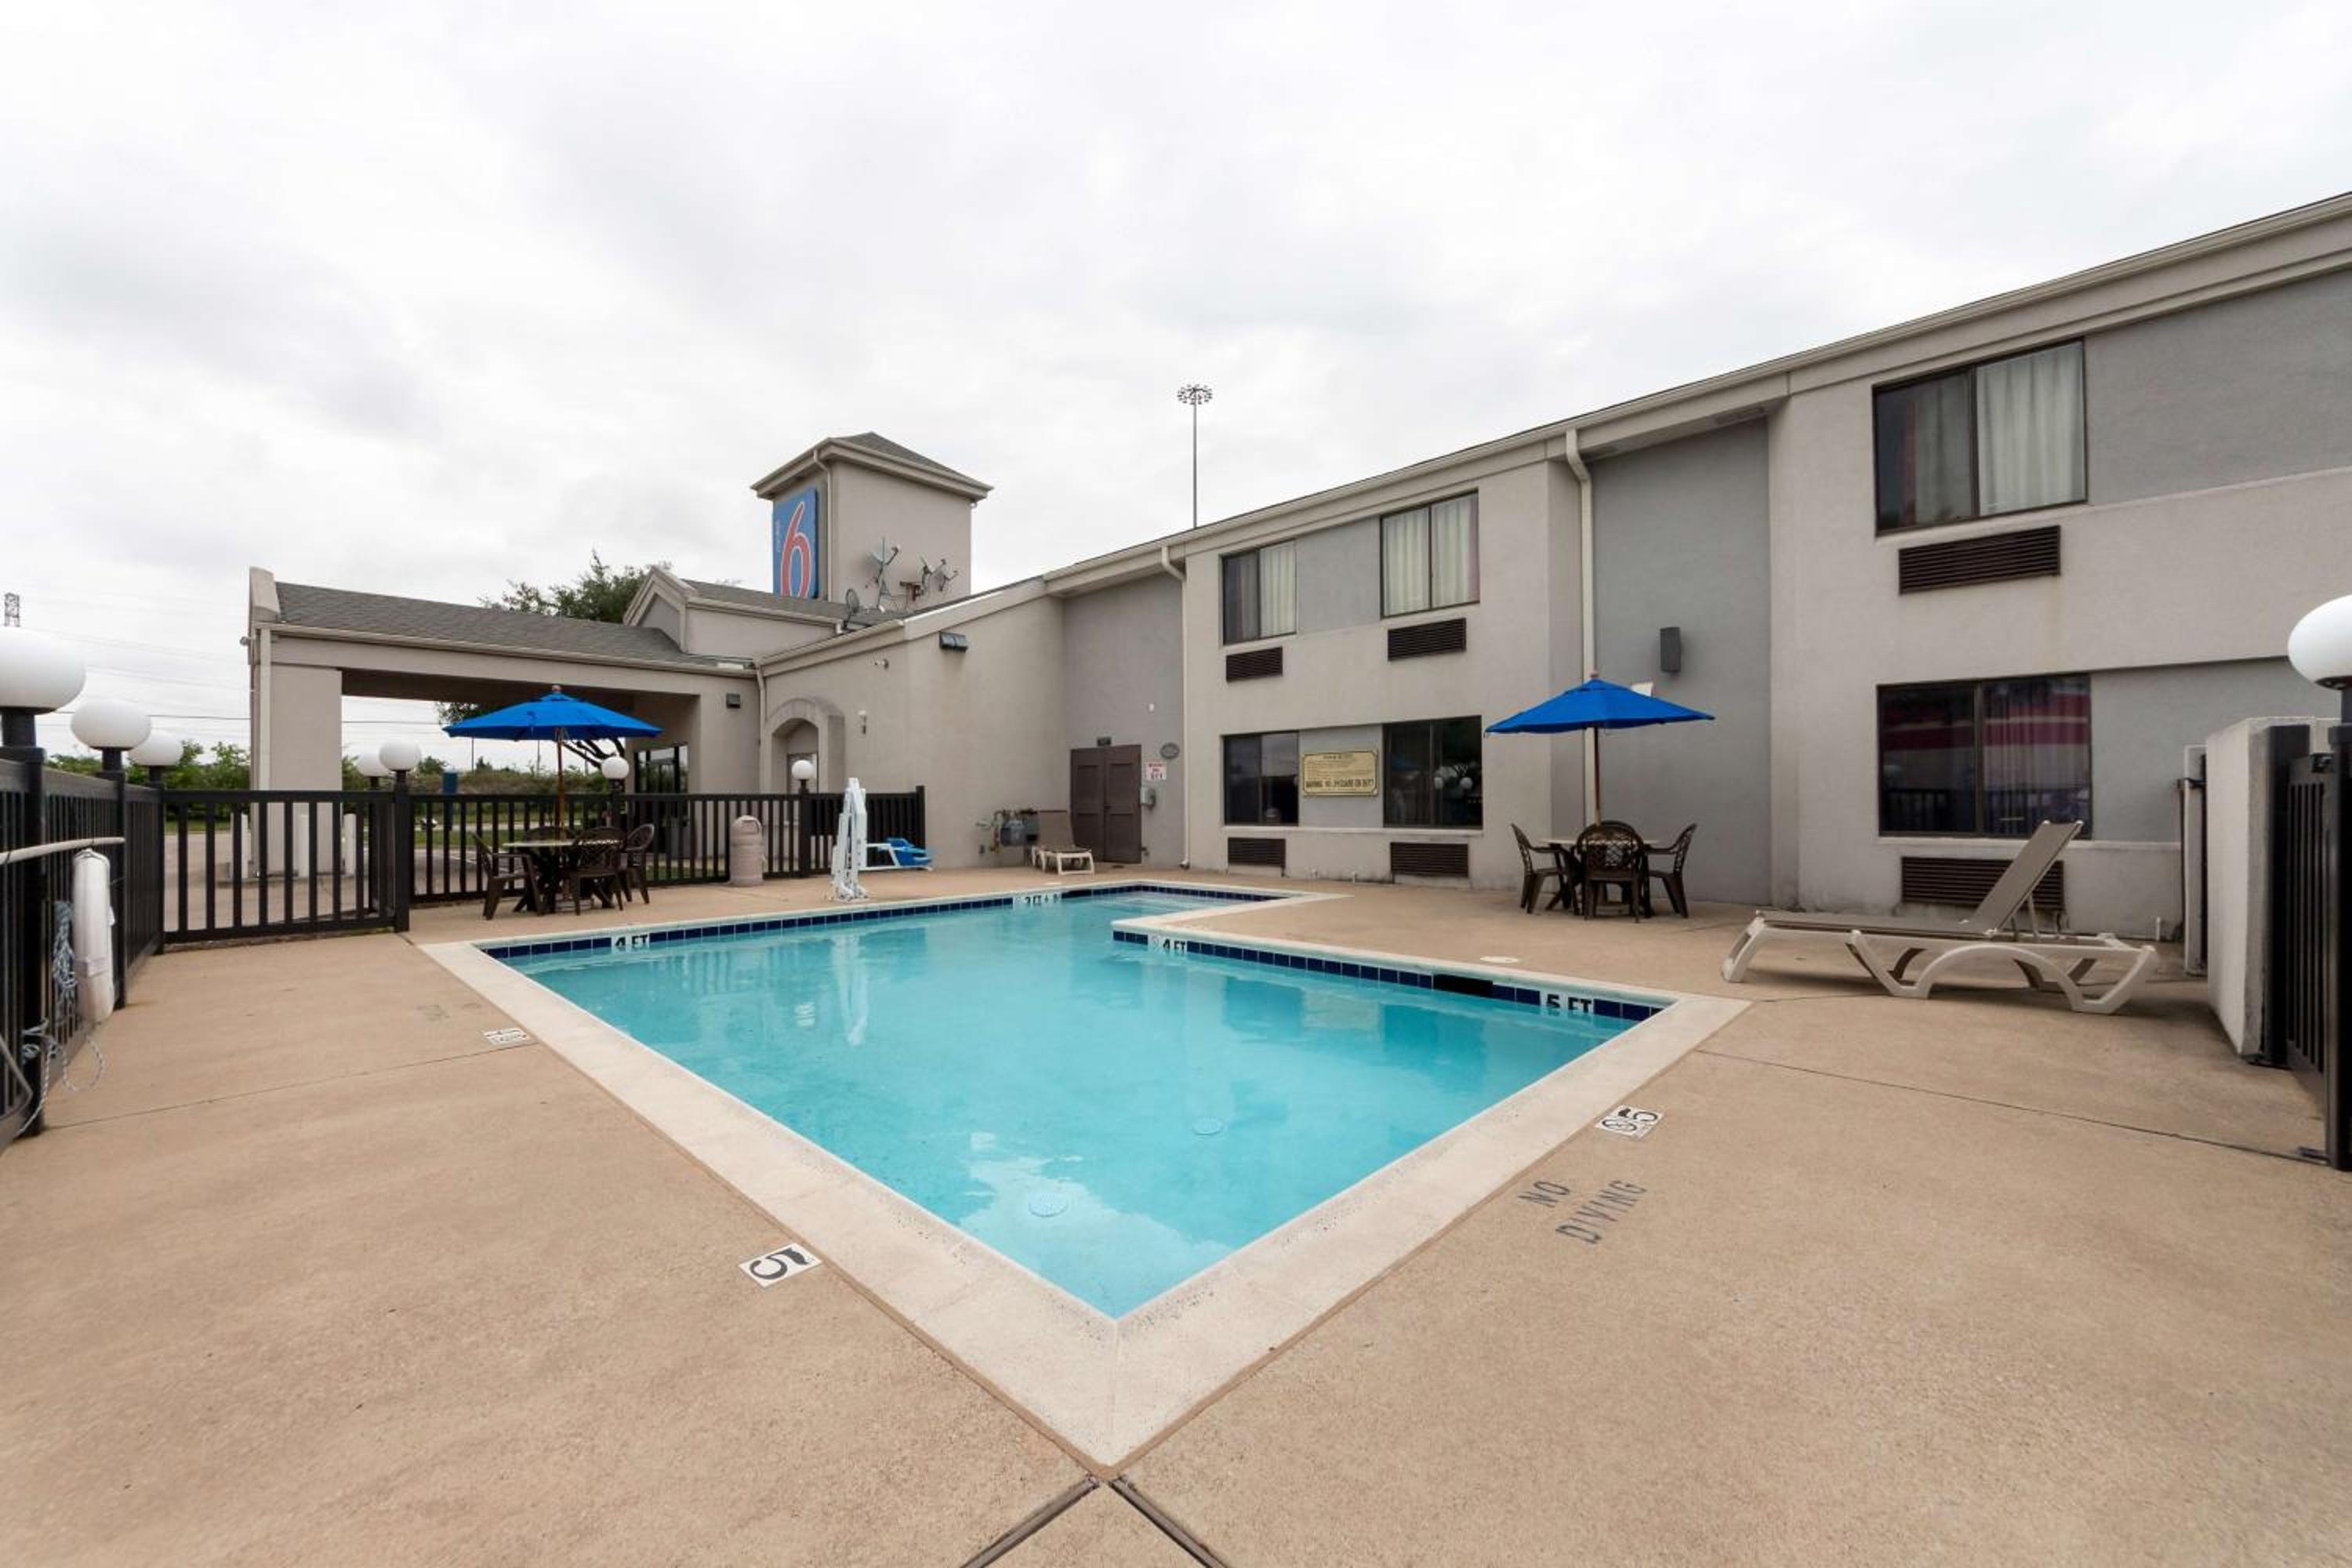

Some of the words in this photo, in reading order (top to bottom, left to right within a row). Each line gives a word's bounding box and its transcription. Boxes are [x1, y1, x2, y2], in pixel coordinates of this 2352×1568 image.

[781, 502, 812, 599] 6
[1546, 993, 1561, 1009] 5
[1568, 996, 1592, 1013] FT
[1517, 1180, 1571, 1208] NO
[1555, 1179, 1648, 1244] DIVING
[749, 1247, 811, 1280] 5
